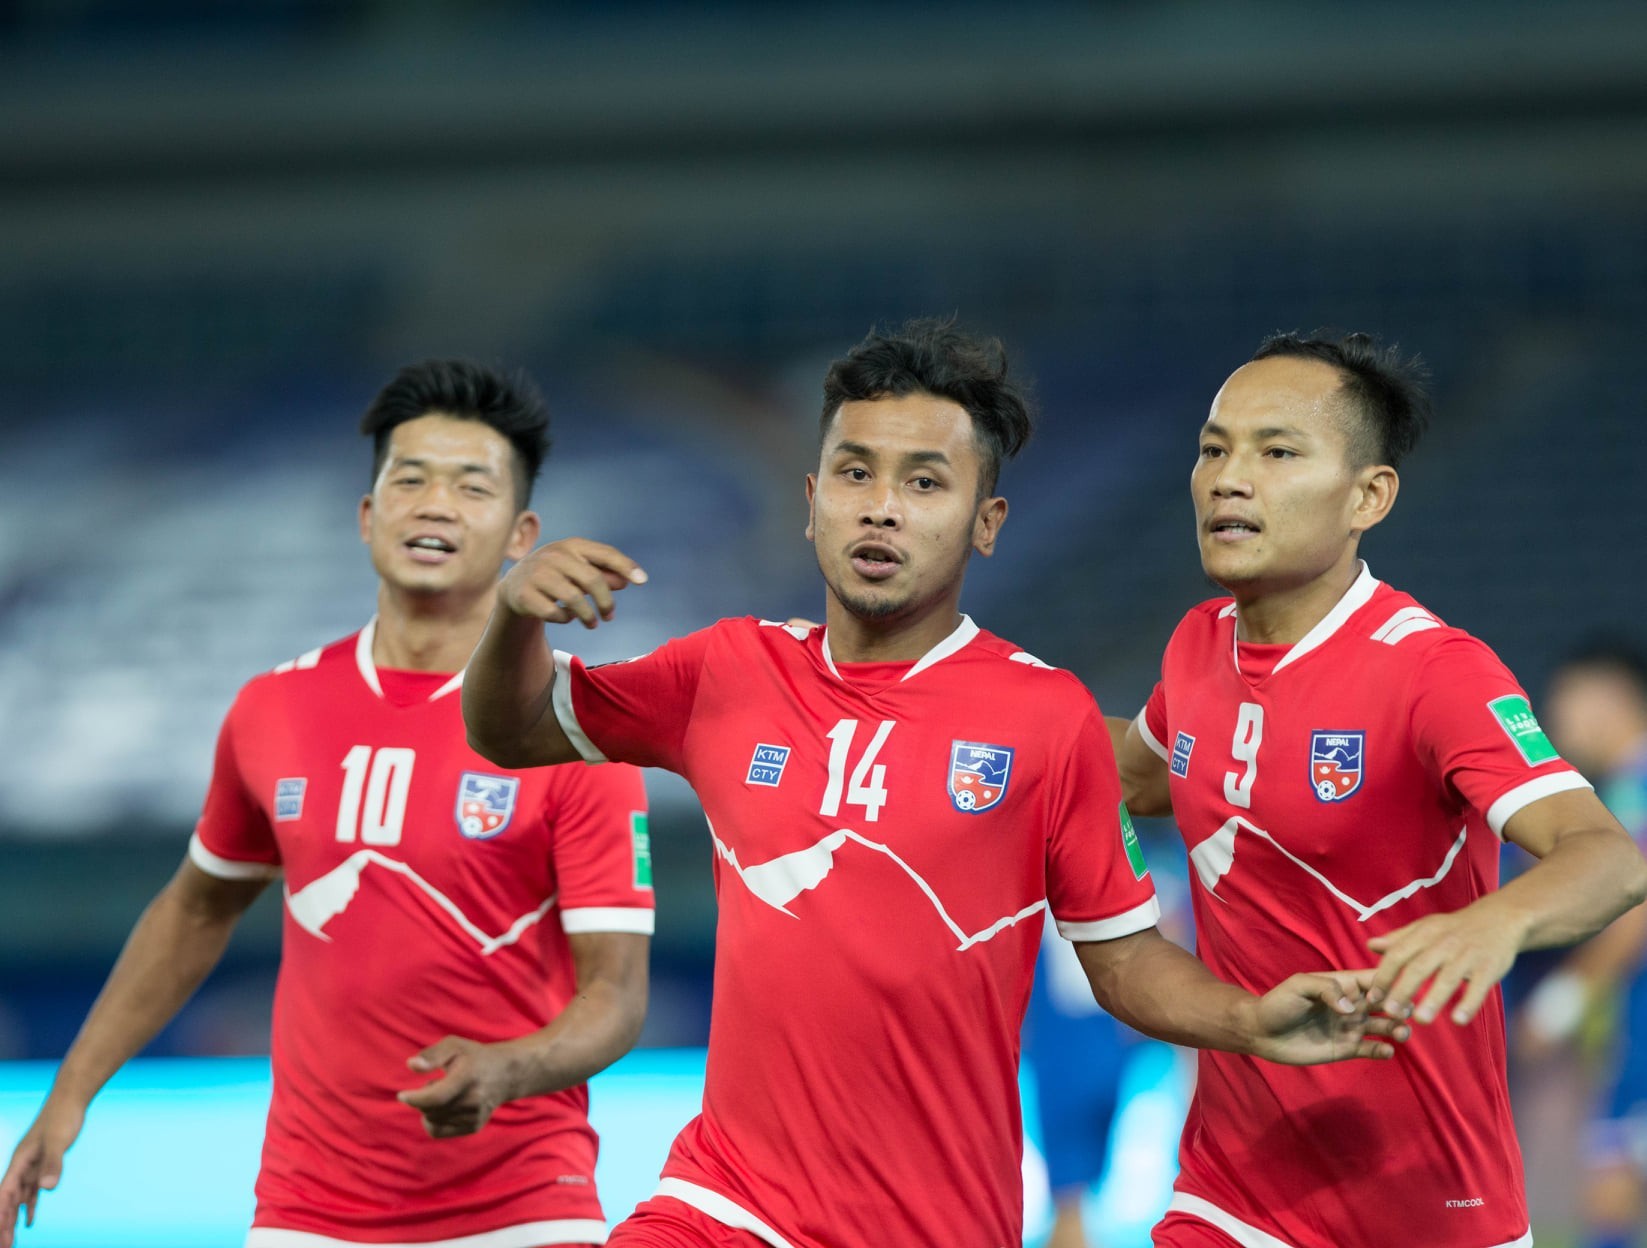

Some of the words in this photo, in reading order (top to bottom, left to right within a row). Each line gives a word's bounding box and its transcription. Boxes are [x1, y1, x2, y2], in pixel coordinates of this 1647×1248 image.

[1175, 737, 1191, 752] KTM
[1325, 738, 1350, 746] NEPAL
[757, 749, 785, 763] KTM
[969, 749, 996, 761] NEPAL
[1223, 702, 1264, 809] 9
[819, 718, 897, 822] 14
[1172, 757, 1186, 771] CTY
[751, 768, 778, 780] CTY
[335, 745, 416, 847] 10
[1446, 1197, 1485, 1207] KTMCOOL
